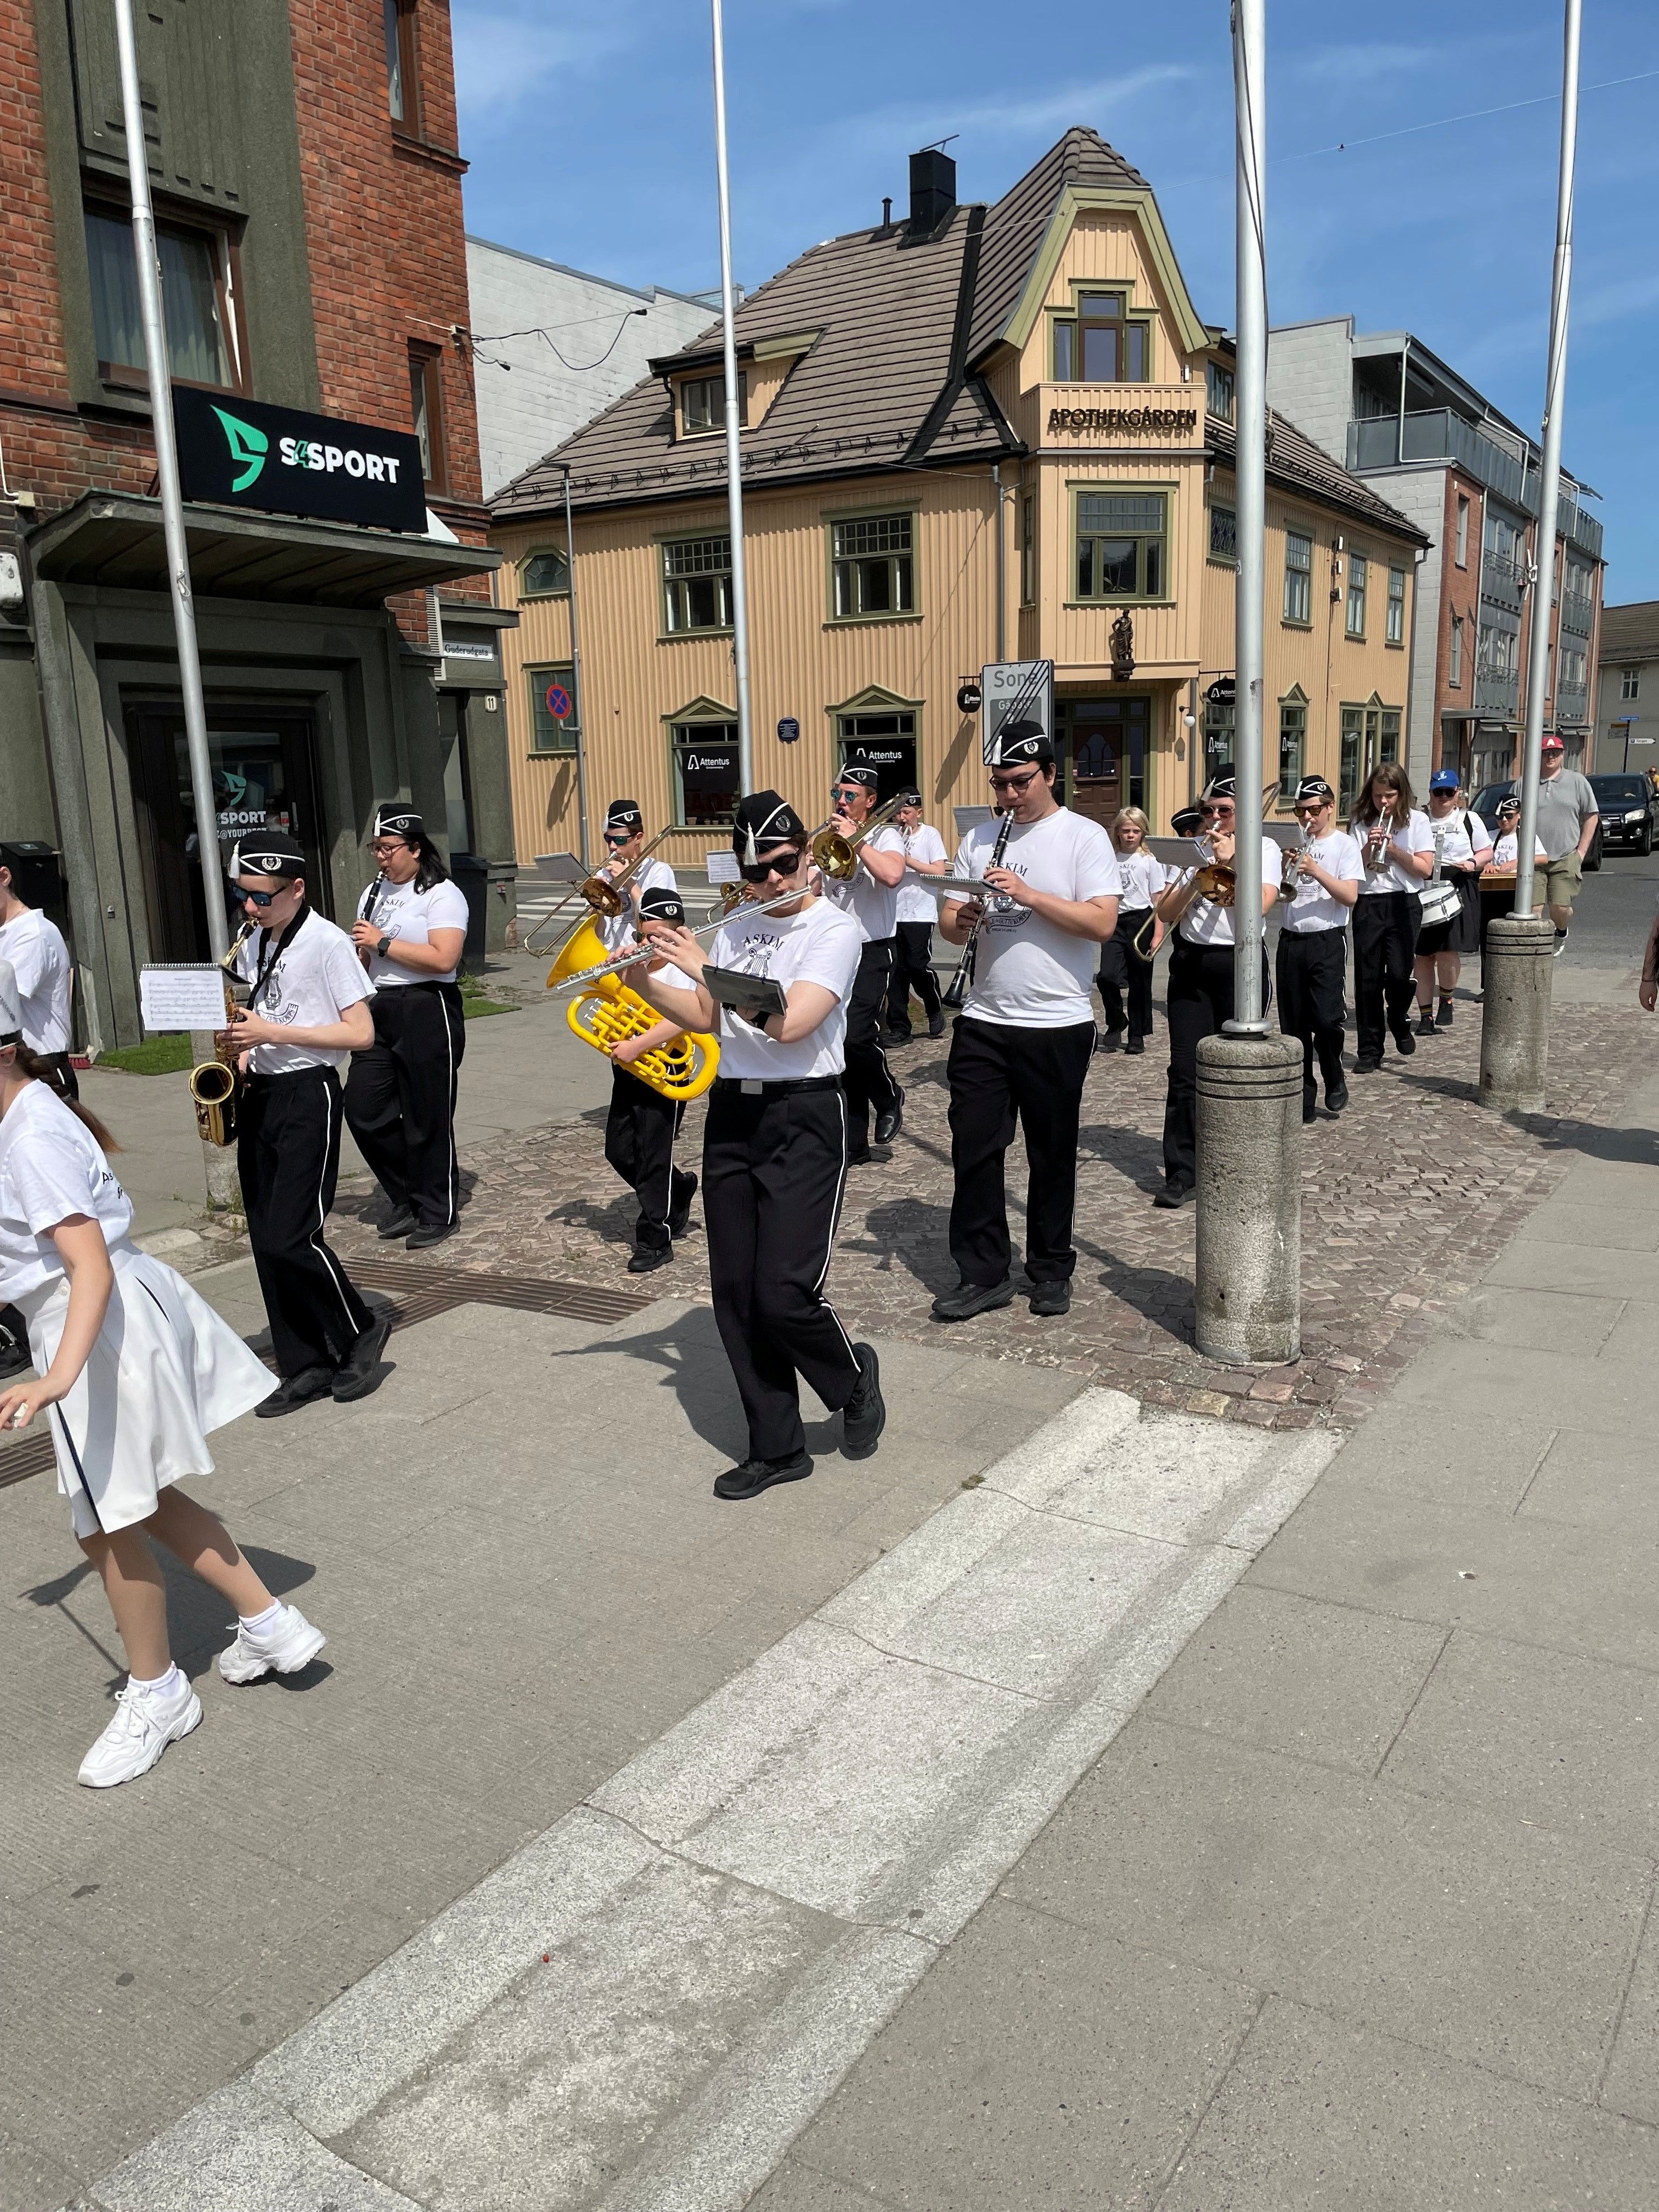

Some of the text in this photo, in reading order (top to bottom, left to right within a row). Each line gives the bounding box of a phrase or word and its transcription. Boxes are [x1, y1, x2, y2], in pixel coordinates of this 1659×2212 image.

[445, 644, 488, 657] Guderudgata
[994, 670, 1037, 687] Sone
[488, 697, 494, 709] 11
[868, 751, 902, 759] Attentus
[700, 758, 730, 766] Attentus
[743, 934, 785, 951] ASKIM
